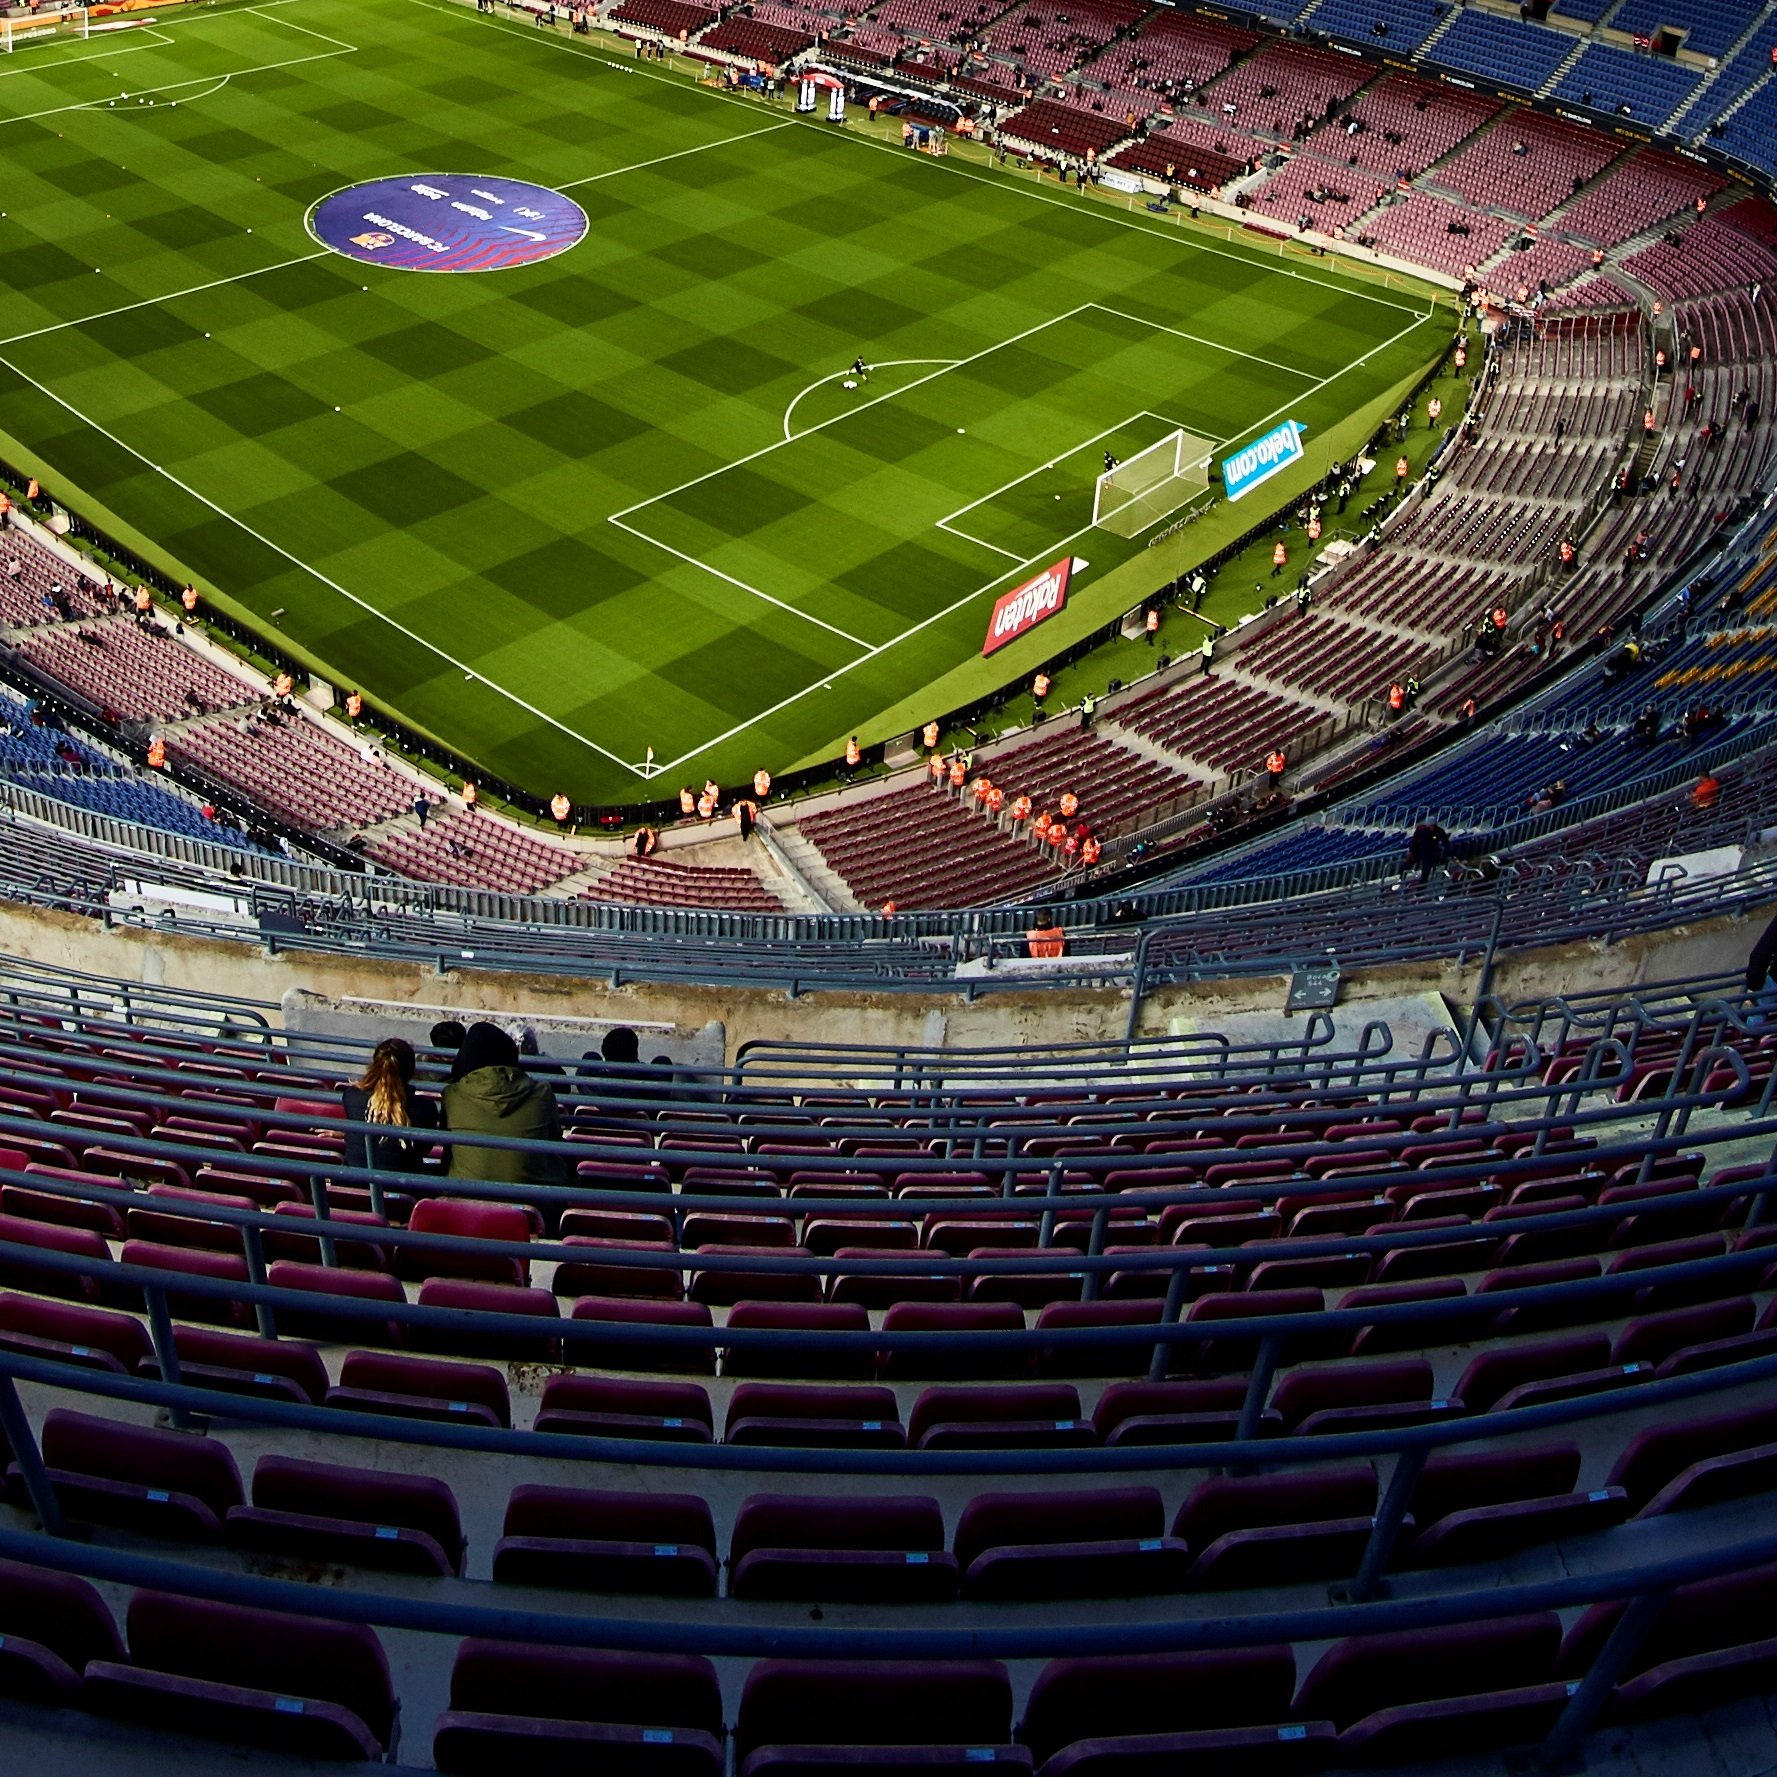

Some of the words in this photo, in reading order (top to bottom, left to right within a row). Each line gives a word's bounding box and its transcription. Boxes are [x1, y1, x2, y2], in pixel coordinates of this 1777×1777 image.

[362, 212, 434, 248] BARCELONA
[1226, 425, 1296, 486] beko.com
[994, 573, 1062, 637] Rakuten
